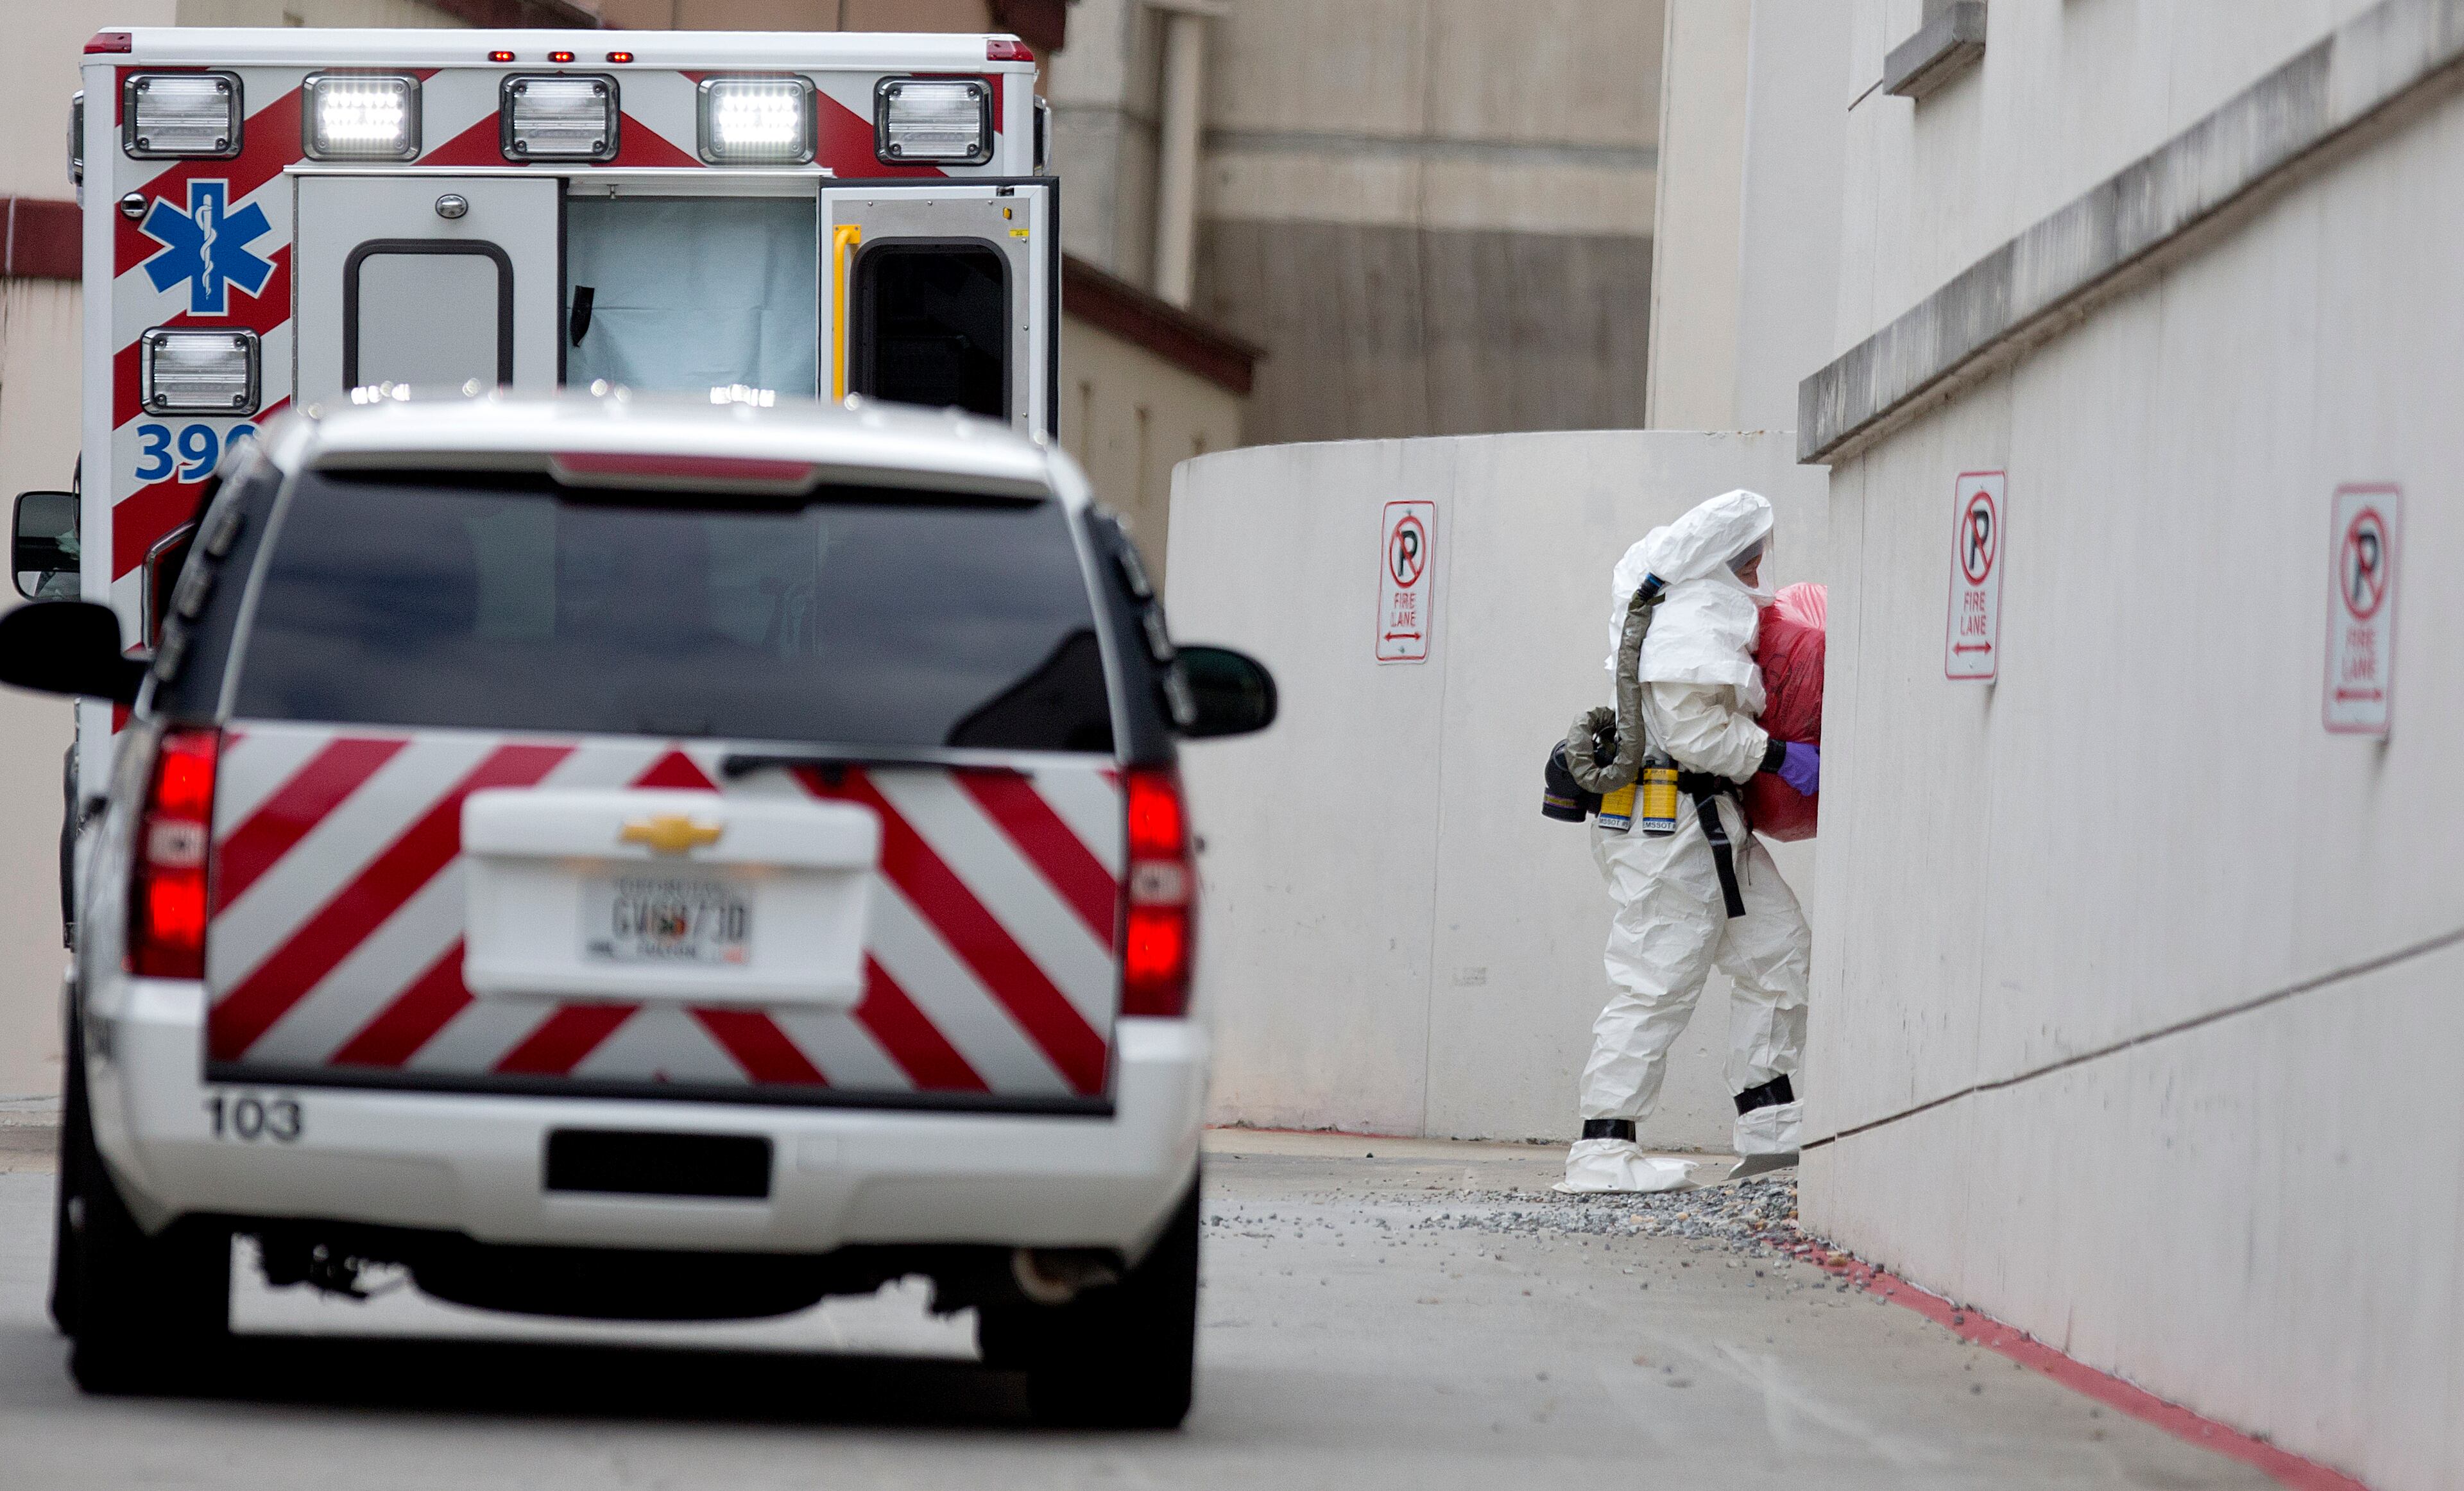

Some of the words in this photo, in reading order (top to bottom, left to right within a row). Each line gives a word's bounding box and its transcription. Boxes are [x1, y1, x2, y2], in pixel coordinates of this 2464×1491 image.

[1393, 592, 1417, 609] FIRE
[1963, 590, 1986, 612] FIRE
[1390, 611, 1417, 628] LANE
[1960, 615, 1987, 636] LANE
[201, 1098, 300, 1142] 103
